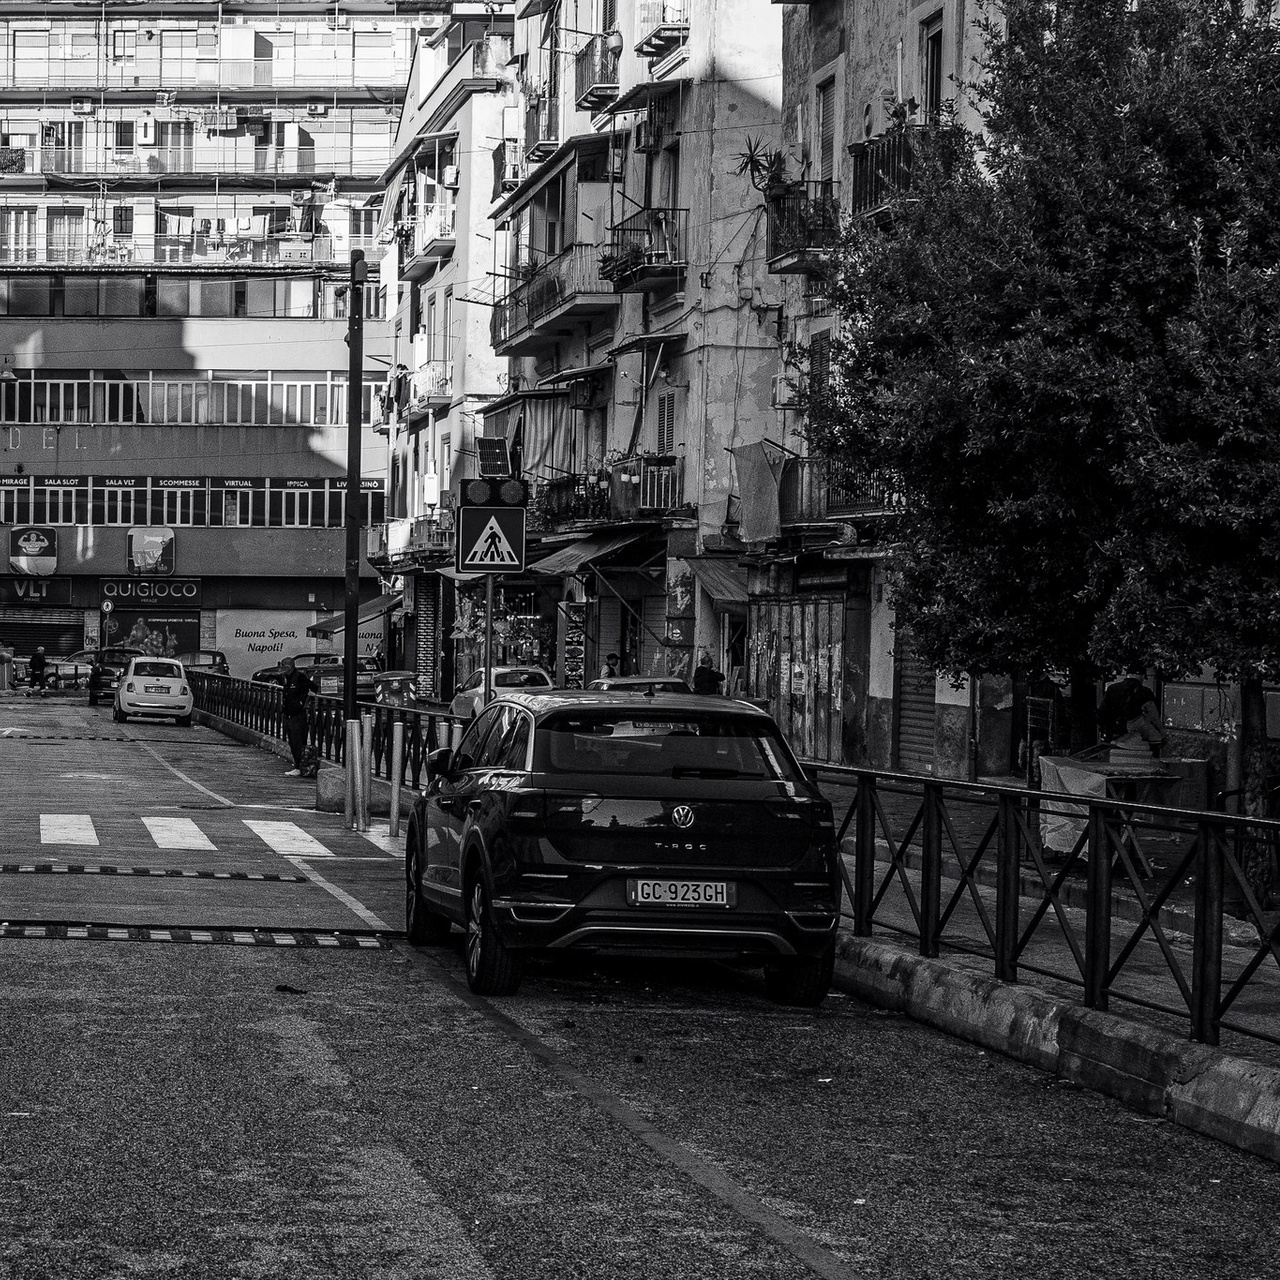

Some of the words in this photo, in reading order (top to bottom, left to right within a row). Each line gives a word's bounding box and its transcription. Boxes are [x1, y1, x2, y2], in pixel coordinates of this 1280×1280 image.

[13, 580, 51, 597] VLT
[103, 582, 197, 597] QUIGIOCO
[234, 628, 265, 638] Buona
[267, 629, 299, 640] Spesa,
[247, 642, 283, 654] Napoli!
[654, 842, 707, 851] T-ROC
[640, 882, 662, 901] GC
[668, 883, 725, 903] 923GH
